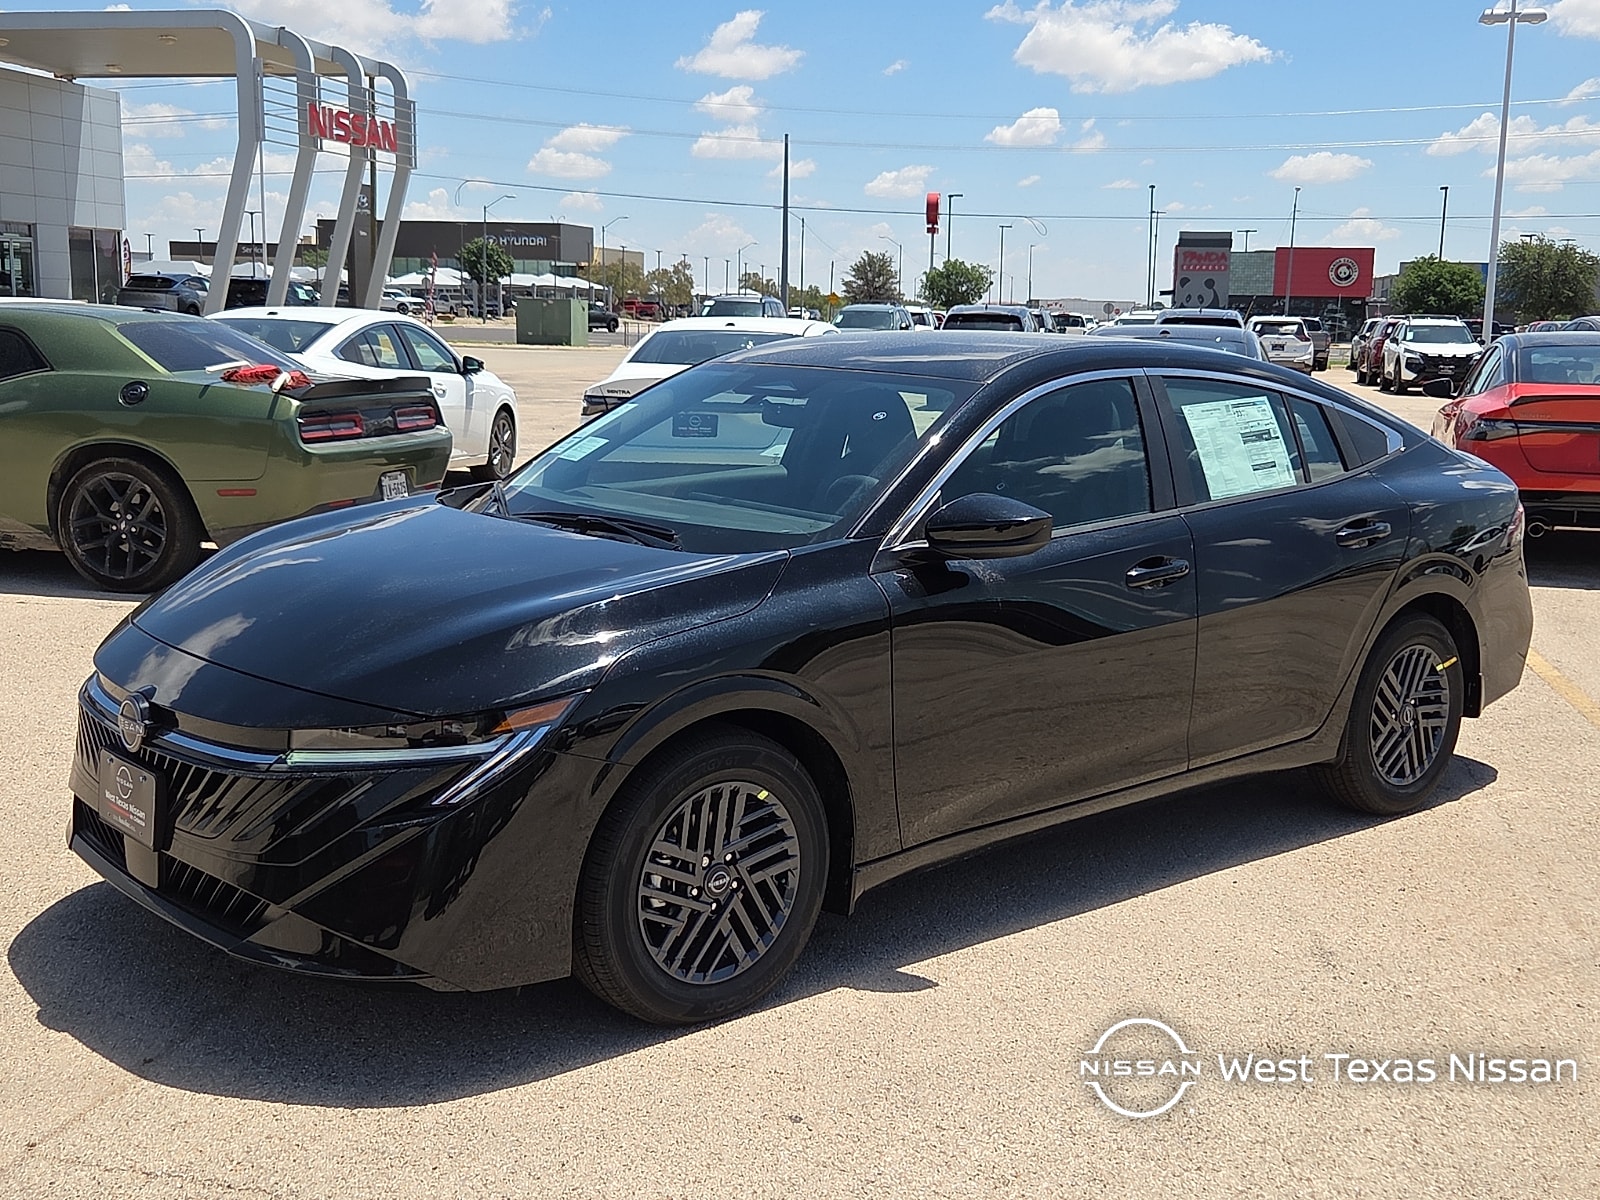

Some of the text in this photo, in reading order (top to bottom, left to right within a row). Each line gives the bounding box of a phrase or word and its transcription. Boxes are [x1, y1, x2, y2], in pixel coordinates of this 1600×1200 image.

[307, 102, 397, 153] NISSAN
[500, 236, 547, 246] HYUNDAI
[1182, 251, 1228, 263] PANDA
[116, 776, 134, 790] NISSAN
[105, 789, 146, 820] West Texas Nissan
